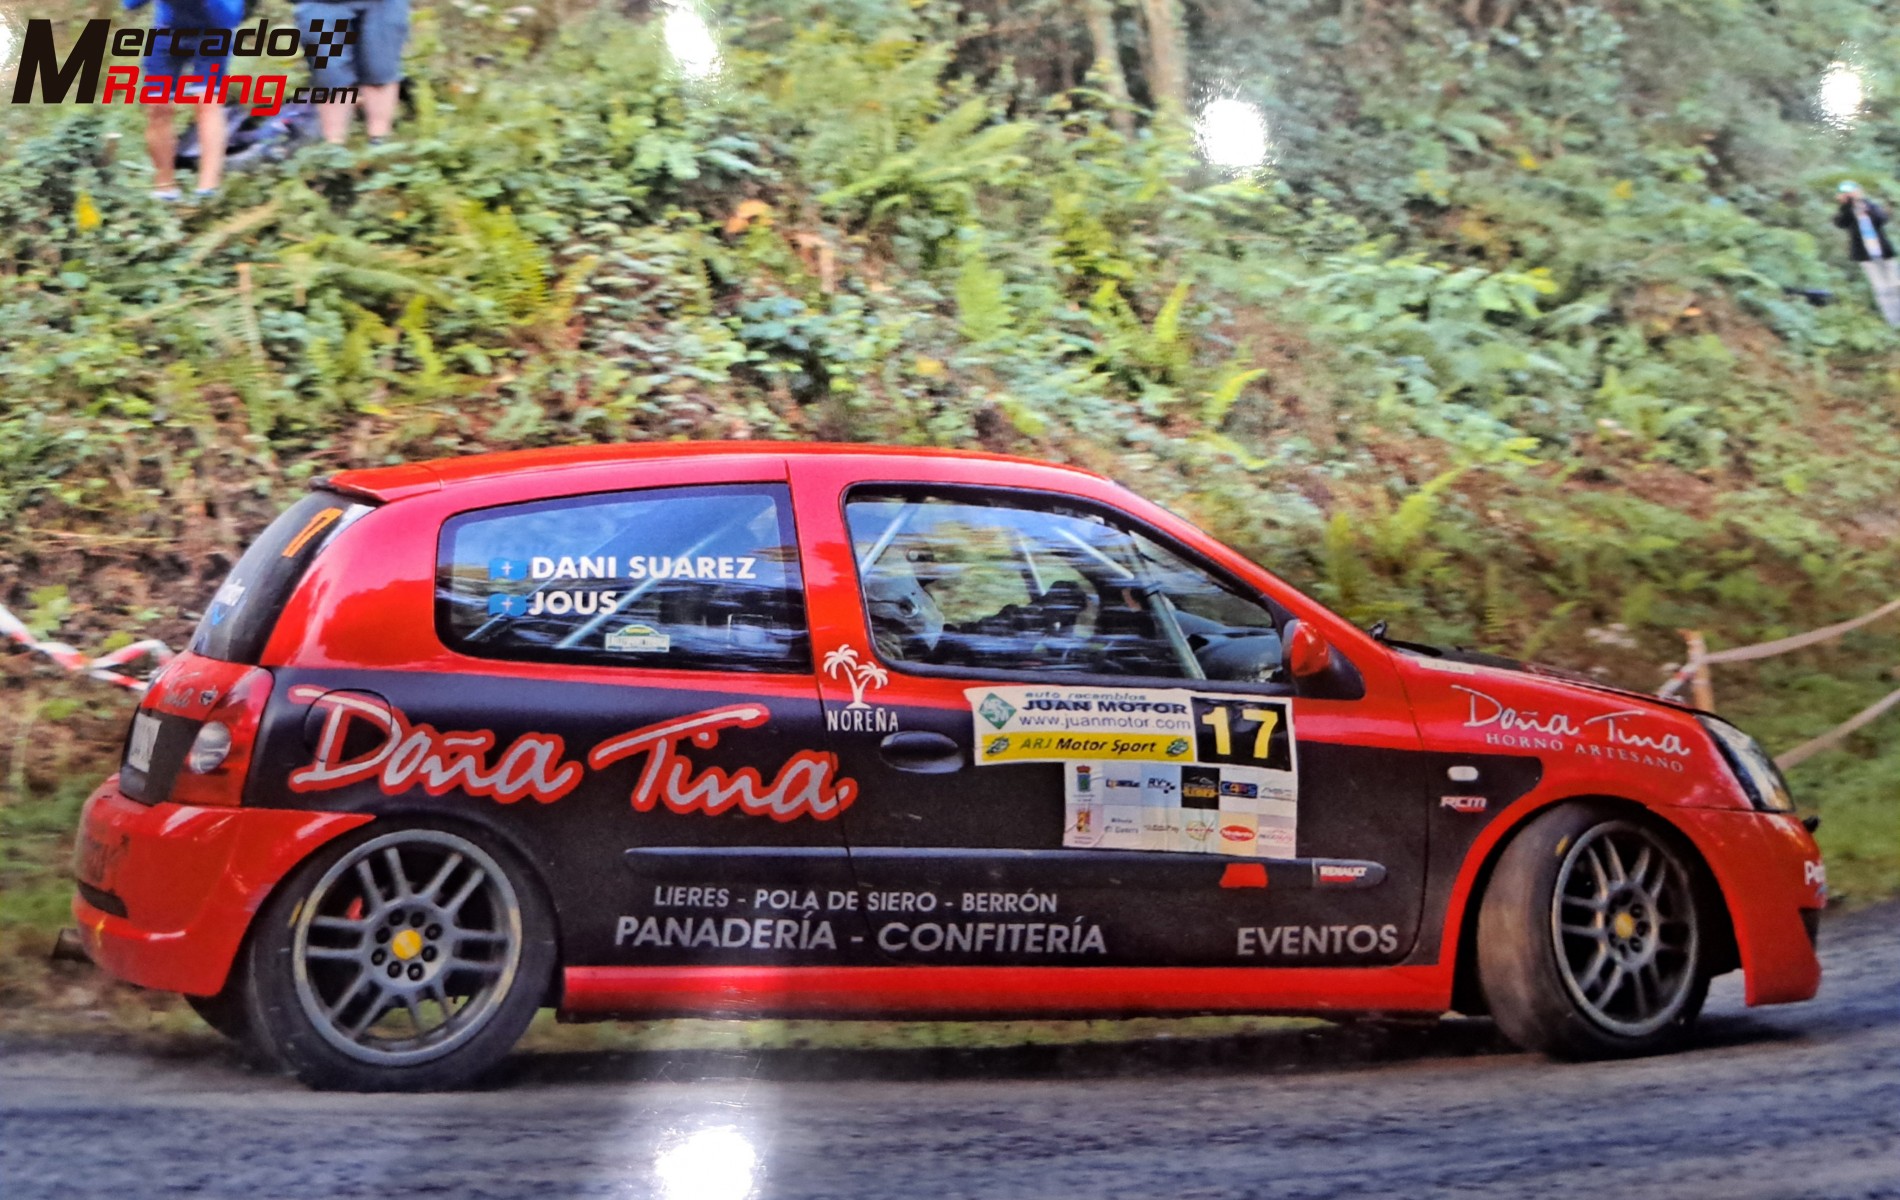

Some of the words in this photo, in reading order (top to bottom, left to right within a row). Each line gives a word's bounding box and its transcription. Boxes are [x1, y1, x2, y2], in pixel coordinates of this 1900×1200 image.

[532, 556, 616, 579] DANI
[629, 557, 756, 580] SUAREZ
[528, 591, 618, 616] JOUS
[827, 708, 898, 732] NOREÑA
[1023, 700, 1092, 711] JUAN
[1098, 702, 1188, 714] MOTOR
[1451, 684, 1579, 736] Doña
[1585, 709, 1690, 756] Tina
[1019, 713, 1191, 730] www.juanmotor.com
[1202, 707, 1278, 759] 17
[289, 686, 580, 801] Doña
[591, 704, 854, 818] Tina
[1056, 738, 1107, 750] Motor
[1111, 740, 1156, 755] Sport
[1485, 732, 1563, 751] HORNO
[1574, 742, 1684, 773] ARTESANO
[654, 886, 730, 907] LIERES
[754, 889, 820, 910] POLA
[827, 891, 858, 911] DE
[867, 892, 937, 912] SIERO
[961, 888, 1057, 913] BERRÓN
[615, 911, 837, 949] PANADERÍA
[877, 916, 1107, 953] CONFITERÍA
[1237, 924, 1398, 955] EVENTOS
